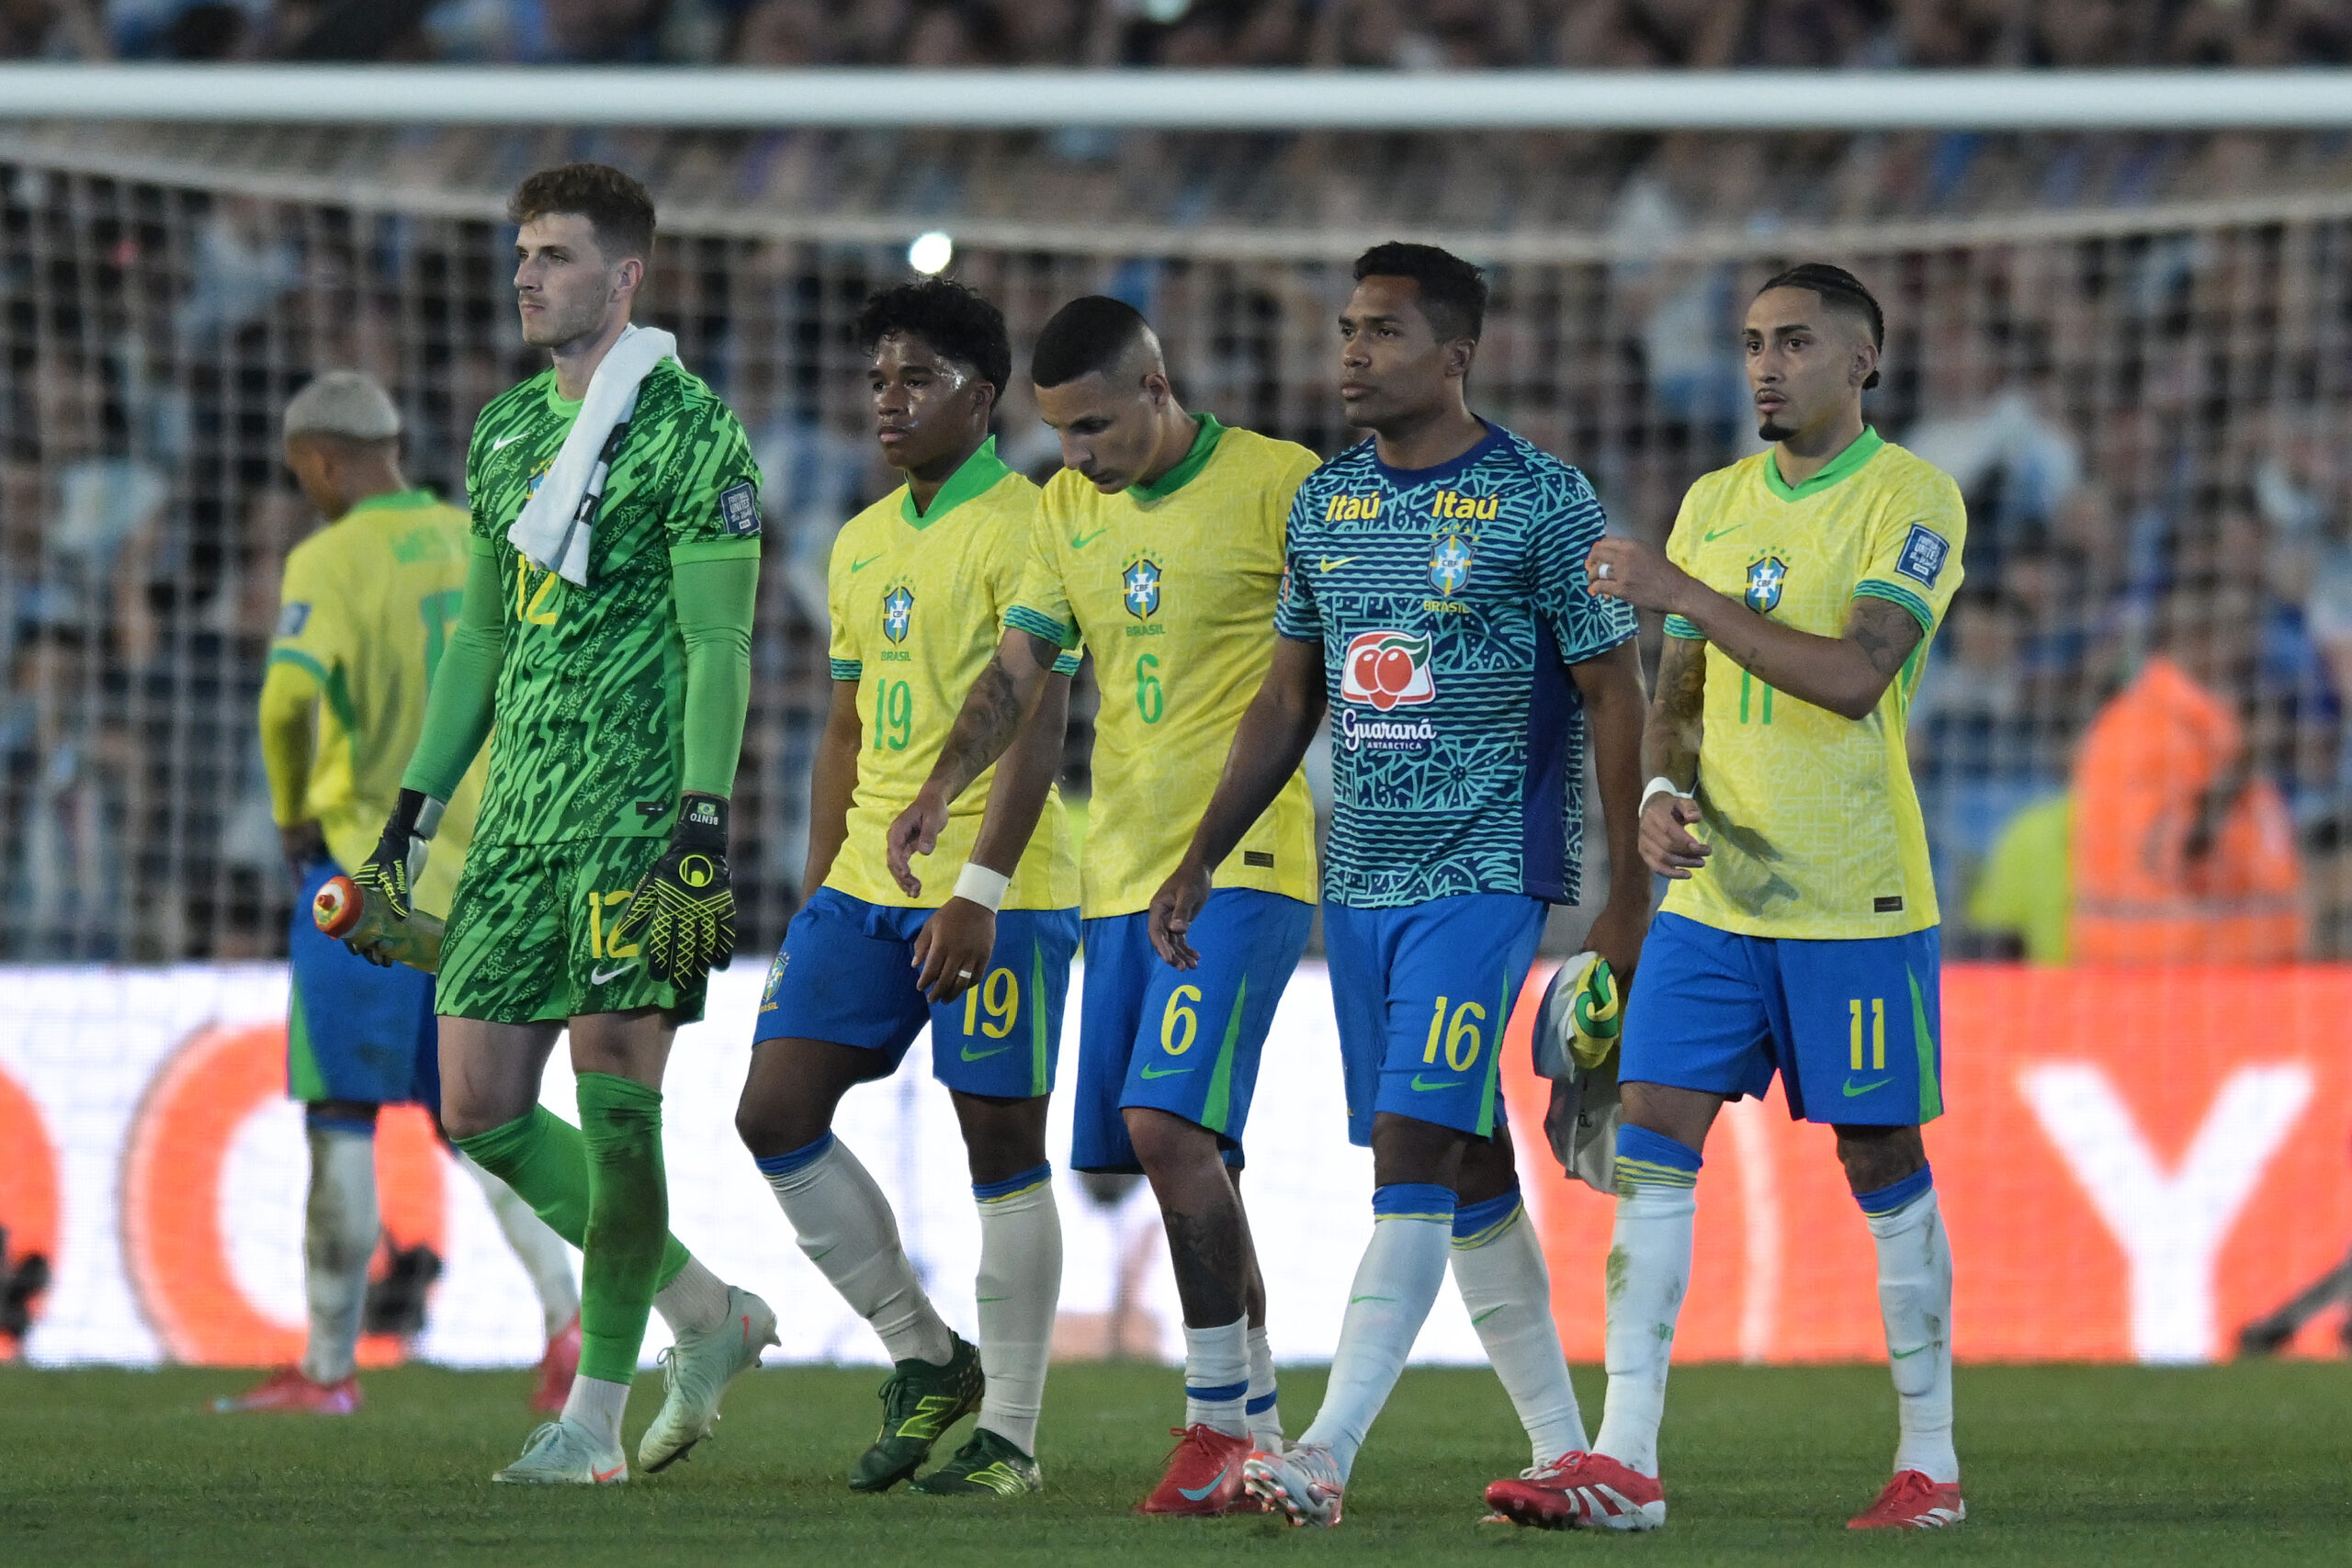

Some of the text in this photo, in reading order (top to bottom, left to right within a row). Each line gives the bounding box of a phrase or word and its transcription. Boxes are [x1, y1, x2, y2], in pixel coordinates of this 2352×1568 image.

[1325, 491, 1380, 522] Itaú
[1431, 490, 1499, 520] Itaú
[1442, 559, 1459, 568] CBF
[1757, 580, 1772, 588] CBF
[516, 554, 558, 626] 12
[1134, 583, 1149, 592] CBF
[1423, 600, 1471, 615] BRASIL
[1125, 624, 1166, 637] BRASIL
[880, 651, 911, 661] BRASIL
[1136, 653, 1163, 725] 6
[1739, 669, 1773, 725] 11
[874, 678, 912, 750] 19
[1342, 708, 1437, 751] Guaraná
[1366, 741, 1422, 750] ANTARCTICA
[690, 813, 718, 826] BENTO
[589, 890, 639, 958] 12
[962, 967, 1019, 1039] 19
[1160, 985, 1202, 1056] 6
[1422, 996, 1486, 1072] 16
[1849, 998, 1884, 1070] 11
[2018, 1058, 2314, 1366] Y
